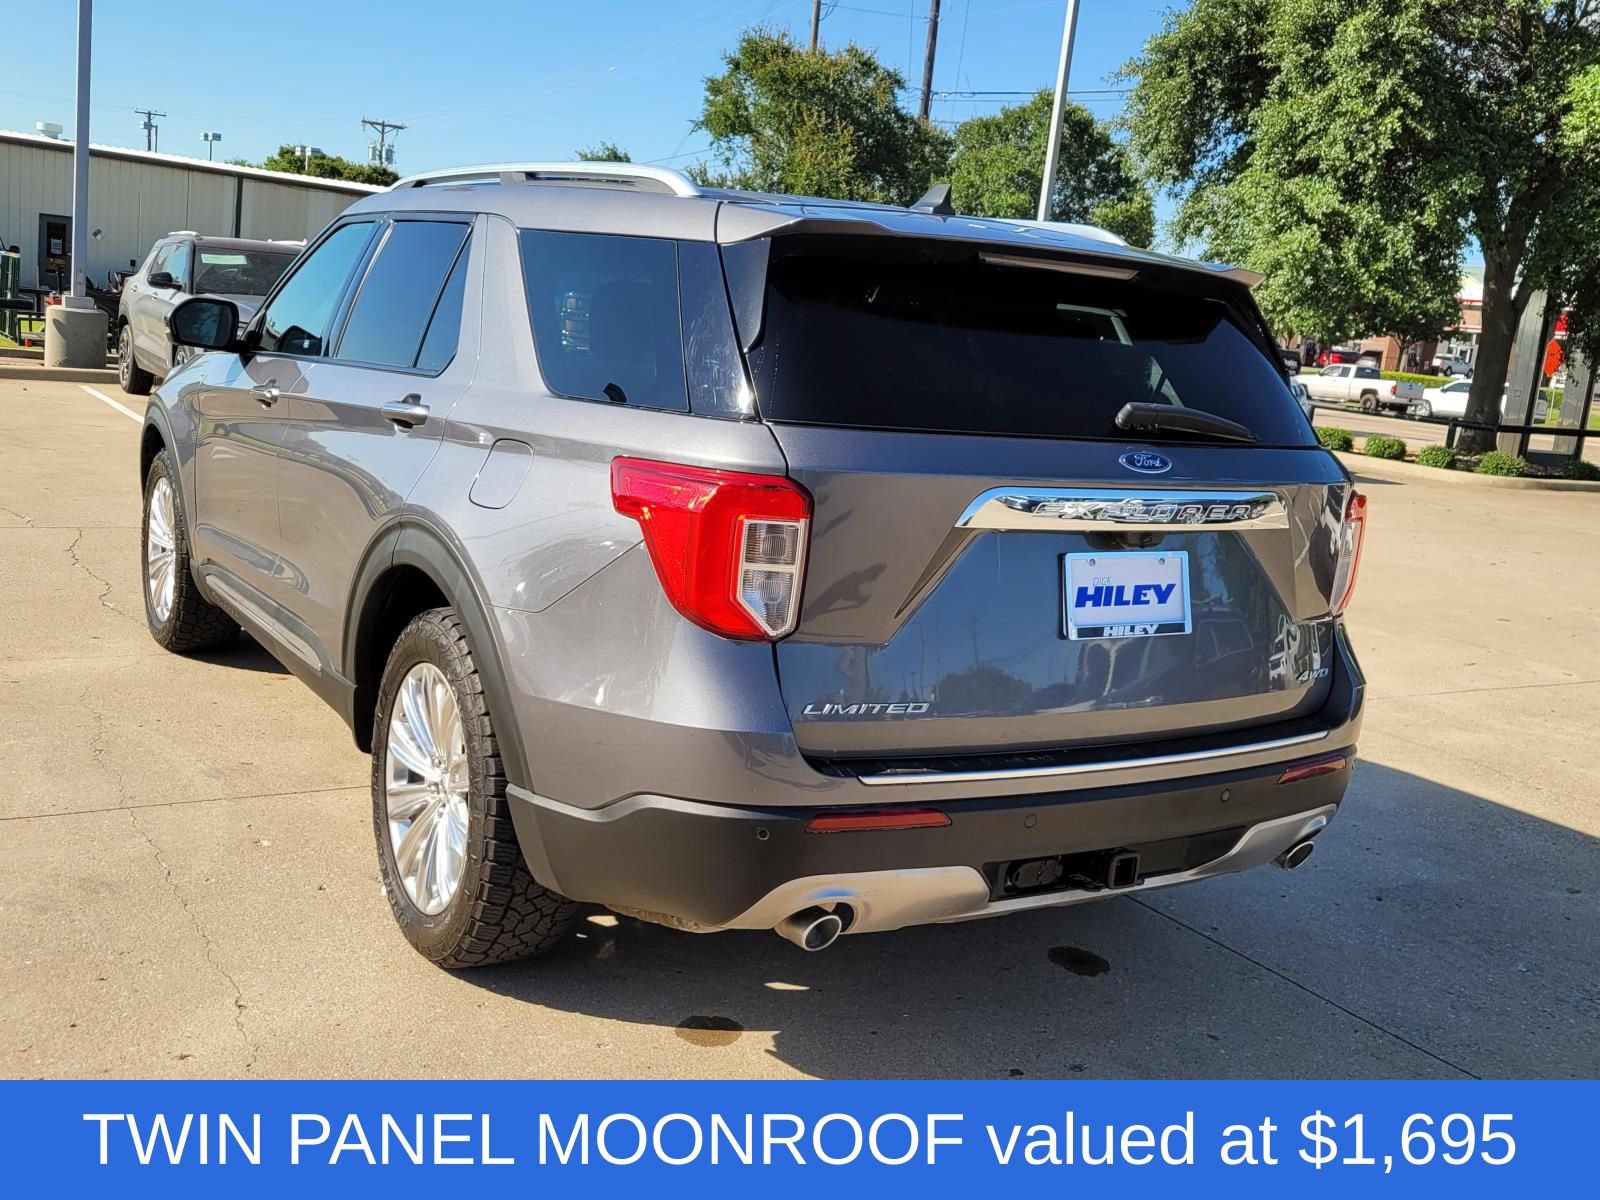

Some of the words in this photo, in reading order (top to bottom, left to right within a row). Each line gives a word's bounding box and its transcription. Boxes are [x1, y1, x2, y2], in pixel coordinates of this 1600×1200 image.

[1134, 453, 1161, 467] Ford
[1092, 575, 1112, 586] pick
[1075, 583, 1176, 608] HILEY
[1103, 624, 1159, 637] HILEY
[802, 702, 929, 715] LIMITED
